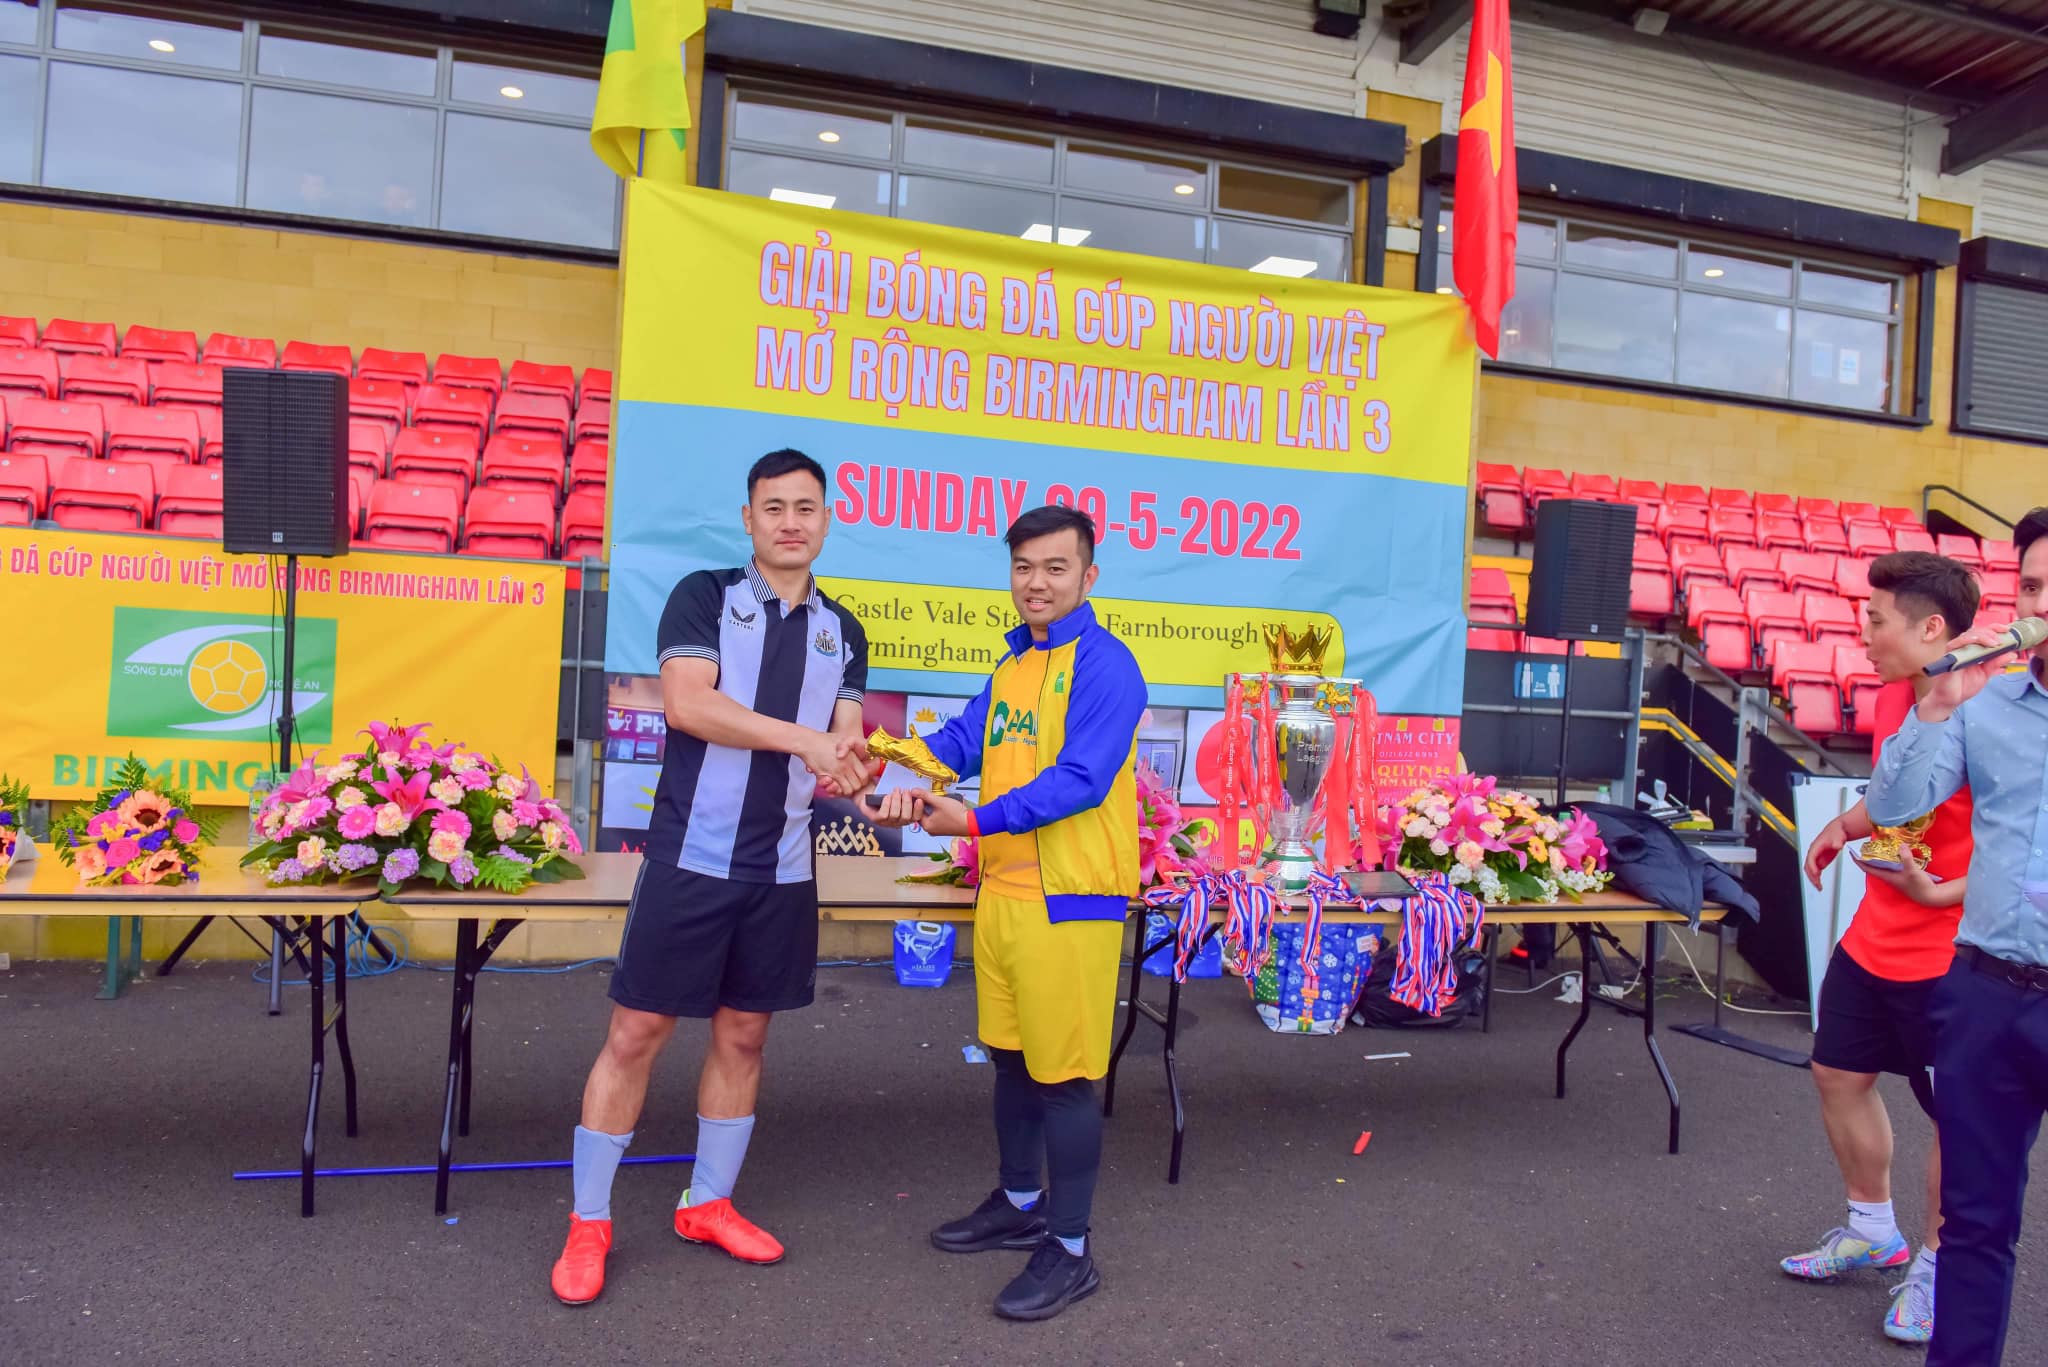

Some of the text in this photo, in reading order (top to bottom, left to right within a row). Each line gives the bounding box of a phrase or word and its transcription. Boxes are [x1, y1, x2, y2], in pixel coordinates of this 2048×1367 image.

[759, 231, 1386, 390] GIẢI BÓNG ĐÁ CÚP NGƯỜI VIỆT
[755, 311, 1391, 454] MỞ RỘNG BIRMINGHAM LẦN 3
[834, 460, 1029, 537] SUNDAY
[11, 544, 40, 575] ĐÁ
[48, 546, 93, 578] CÚP
[101, 550, 171, 583] NGƯỜI
[180, 555, 225, 592] VIỆT
[231, 554, 267, 589] MỞ
[338, 568, 480, 603] BIRMINGHAM
[531, 581, 546, 607] 3
[867, 636, 1000, 668] rmingham,
[923, 600, 977, 626] Vale
[1104, 612, 1258, 650] Farnborough
[303, 680, 320, 690] AN
[1376, 731, 1455, 745] TNAM CITY
